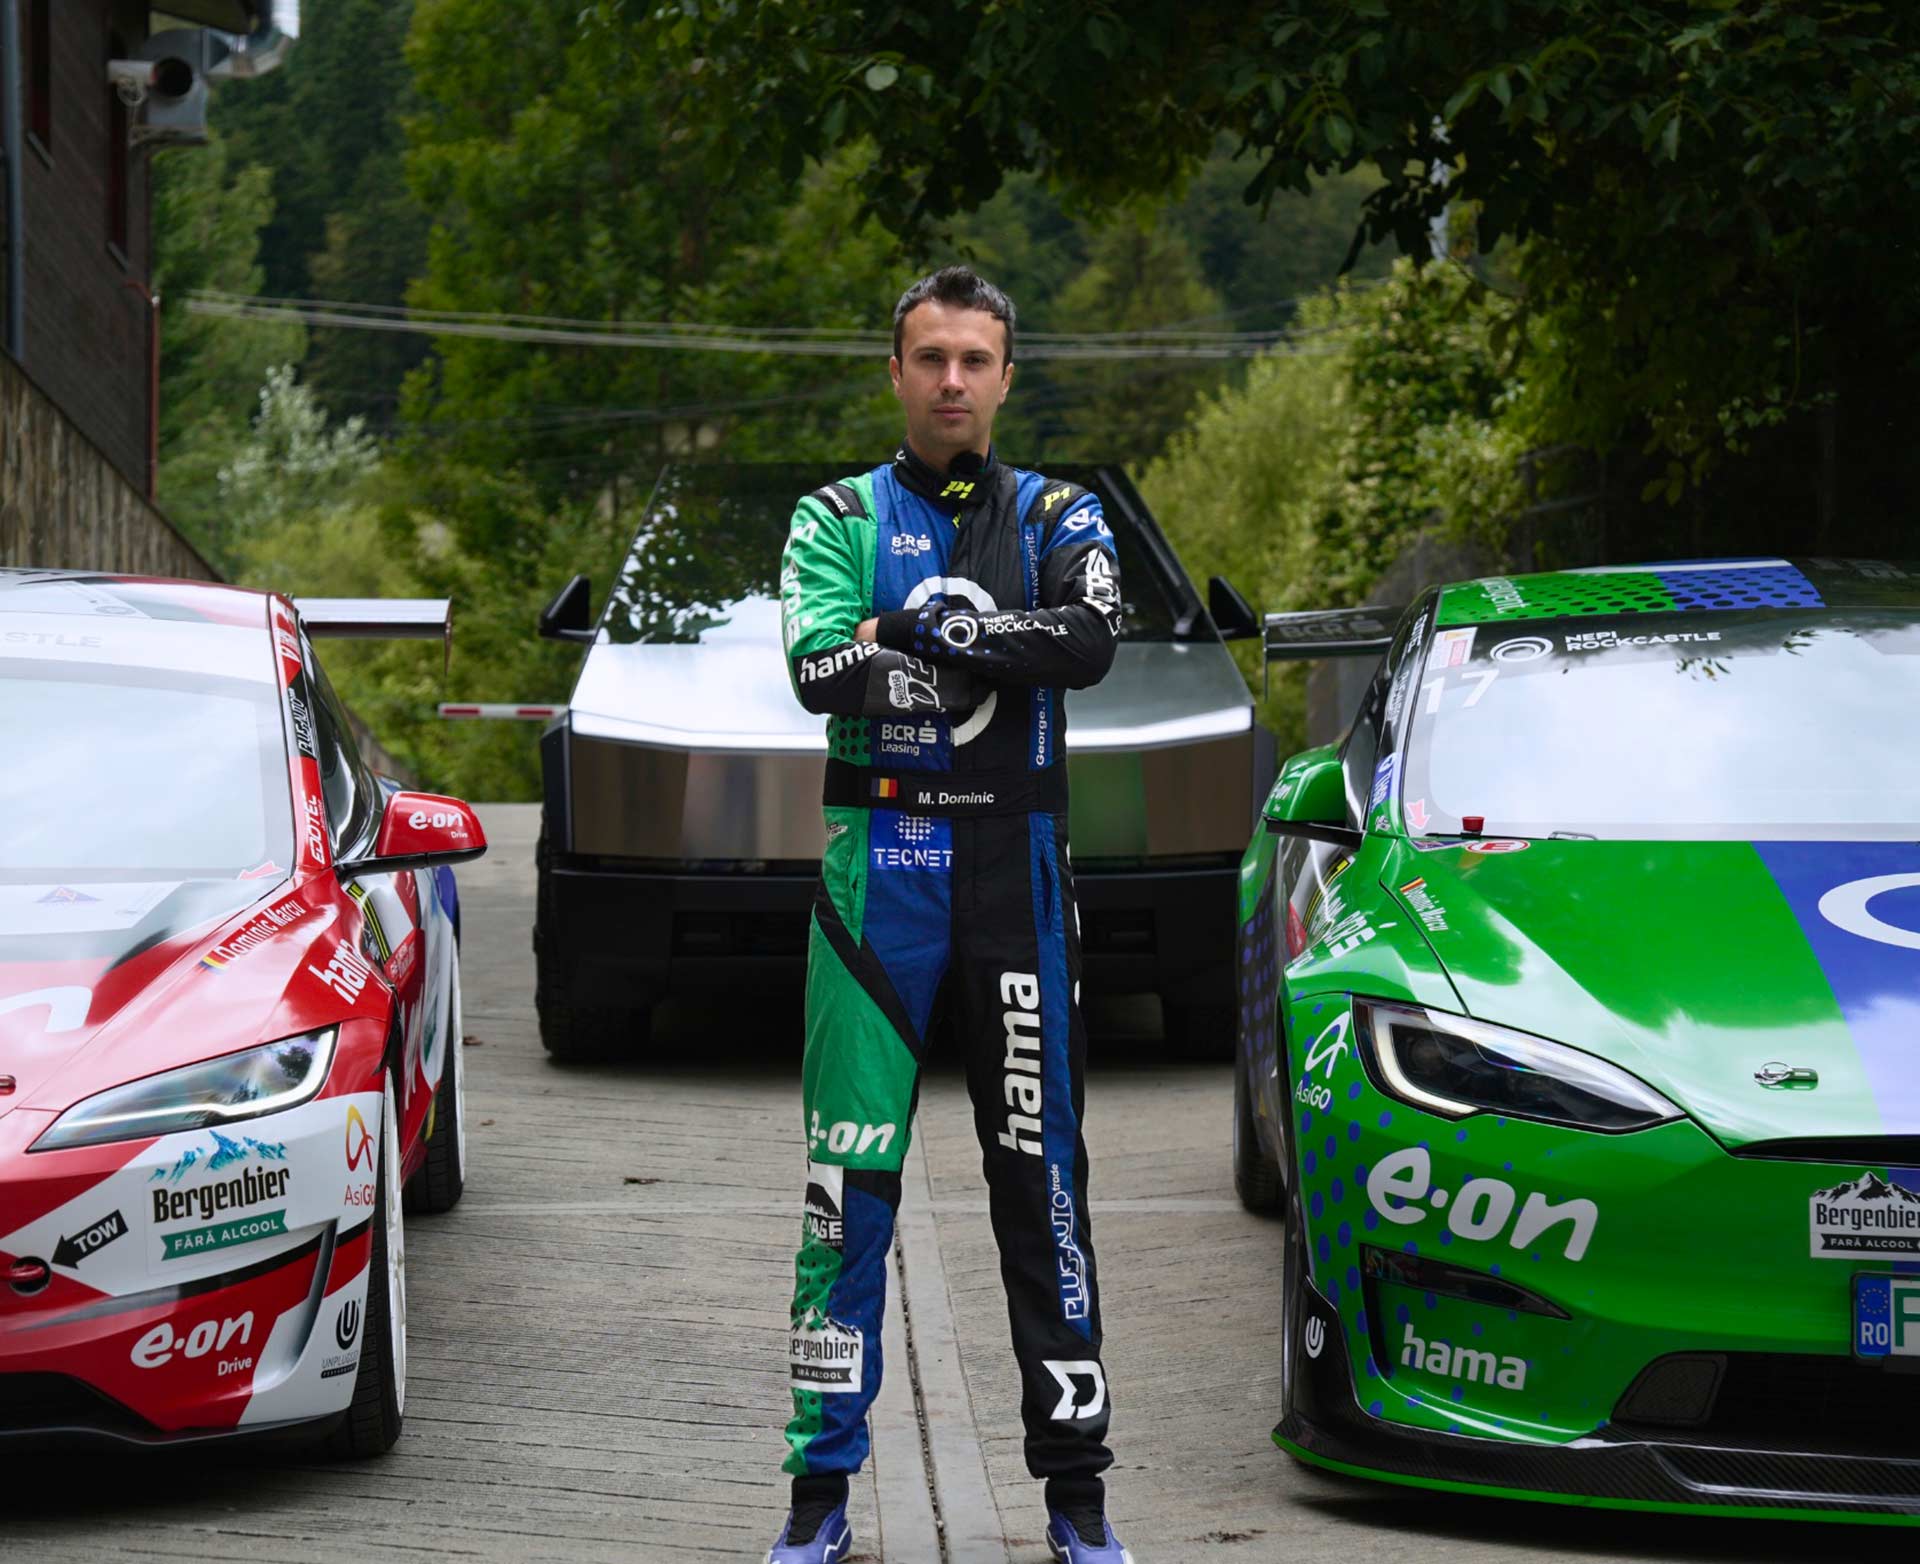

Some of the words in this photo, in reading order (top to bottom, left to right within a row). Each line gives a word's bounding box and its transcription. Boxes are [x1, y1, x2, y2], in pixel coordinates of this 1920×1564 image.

[940, 481, 975, 499] P1
[1043, 487, 1071, 511] P1
[983, 613, 1015, 624] NEPI
[984, 619, 1068, 636] ROCKCALE
[1565, 631, 1617, 643] NEPI
[1566, 632, 1722, 651] ROCKCASTLE
[800, 642, 881, 684] hama
[1422, 669, 1500, 714] 17
[881, 723, 916, 743] BCR
[1036, 707, 1048, 766] George.
[881, 741, 920, 756] Leasing
[918, 791, 934, 805] M.
[938, 790, 994, 805] Dominic
[450, 831, 468, 840] Drive
[873, 848, 953, 868] TECNET
[215, 917, 278, 961] Dominic
[262, 899, 307, 930] Marcu
[998, 971, 1043, 1156] hama
[1295, 1079, 1331, 1109] AsiGO
[1052, 1163, 1061, 1191] trade
[152, 1165, 290, 1223] Bergenbier
[73, 1222, 120, 1254] TOW
[221, 1222, 279, 1242] ALCOOL
[1866, 1239, 1914, 1249] ALCOOL
[1860, 1321, 1889, 1346] RO
[790, 1336, 859, 1360] ergenbier
[1401, 1323, 1527, 1391] hama
[217, 1355, 252, 1377] Drive
